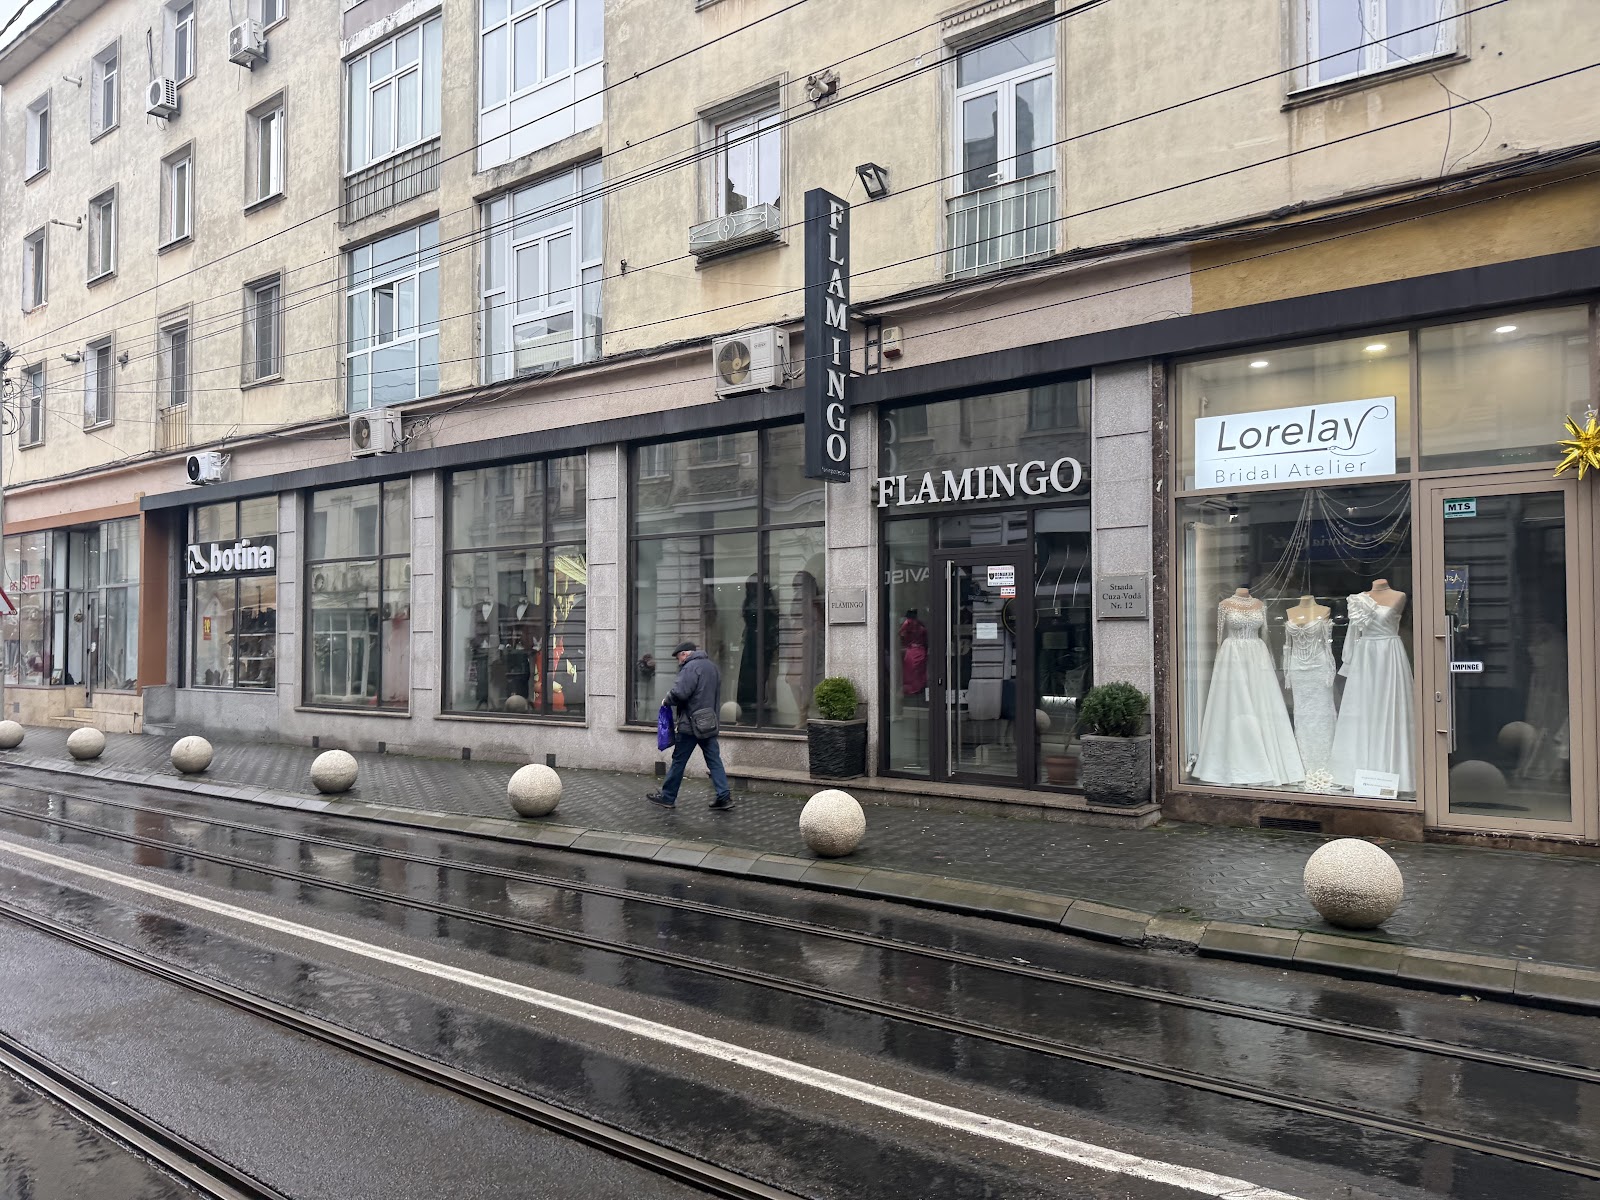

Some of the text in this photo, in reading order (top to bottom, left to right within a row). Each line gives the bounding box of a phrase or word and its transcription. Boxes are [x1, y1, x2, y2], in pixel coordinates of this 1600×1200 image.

[824, 199, 847, 463] FLAMINGO
[1217, 404, 1389, 452] Lorelay
[876, 457, 1082, 508] FLAMINGO
[1215, 459, 1367, 483] Bridal Atelier
[210, 539, 275, 573] botina
[21, 574, 41, 591] STEP
[1109, 583, 1134, 591] Strada
[831, 601, 864, 609] FLAMINGO
